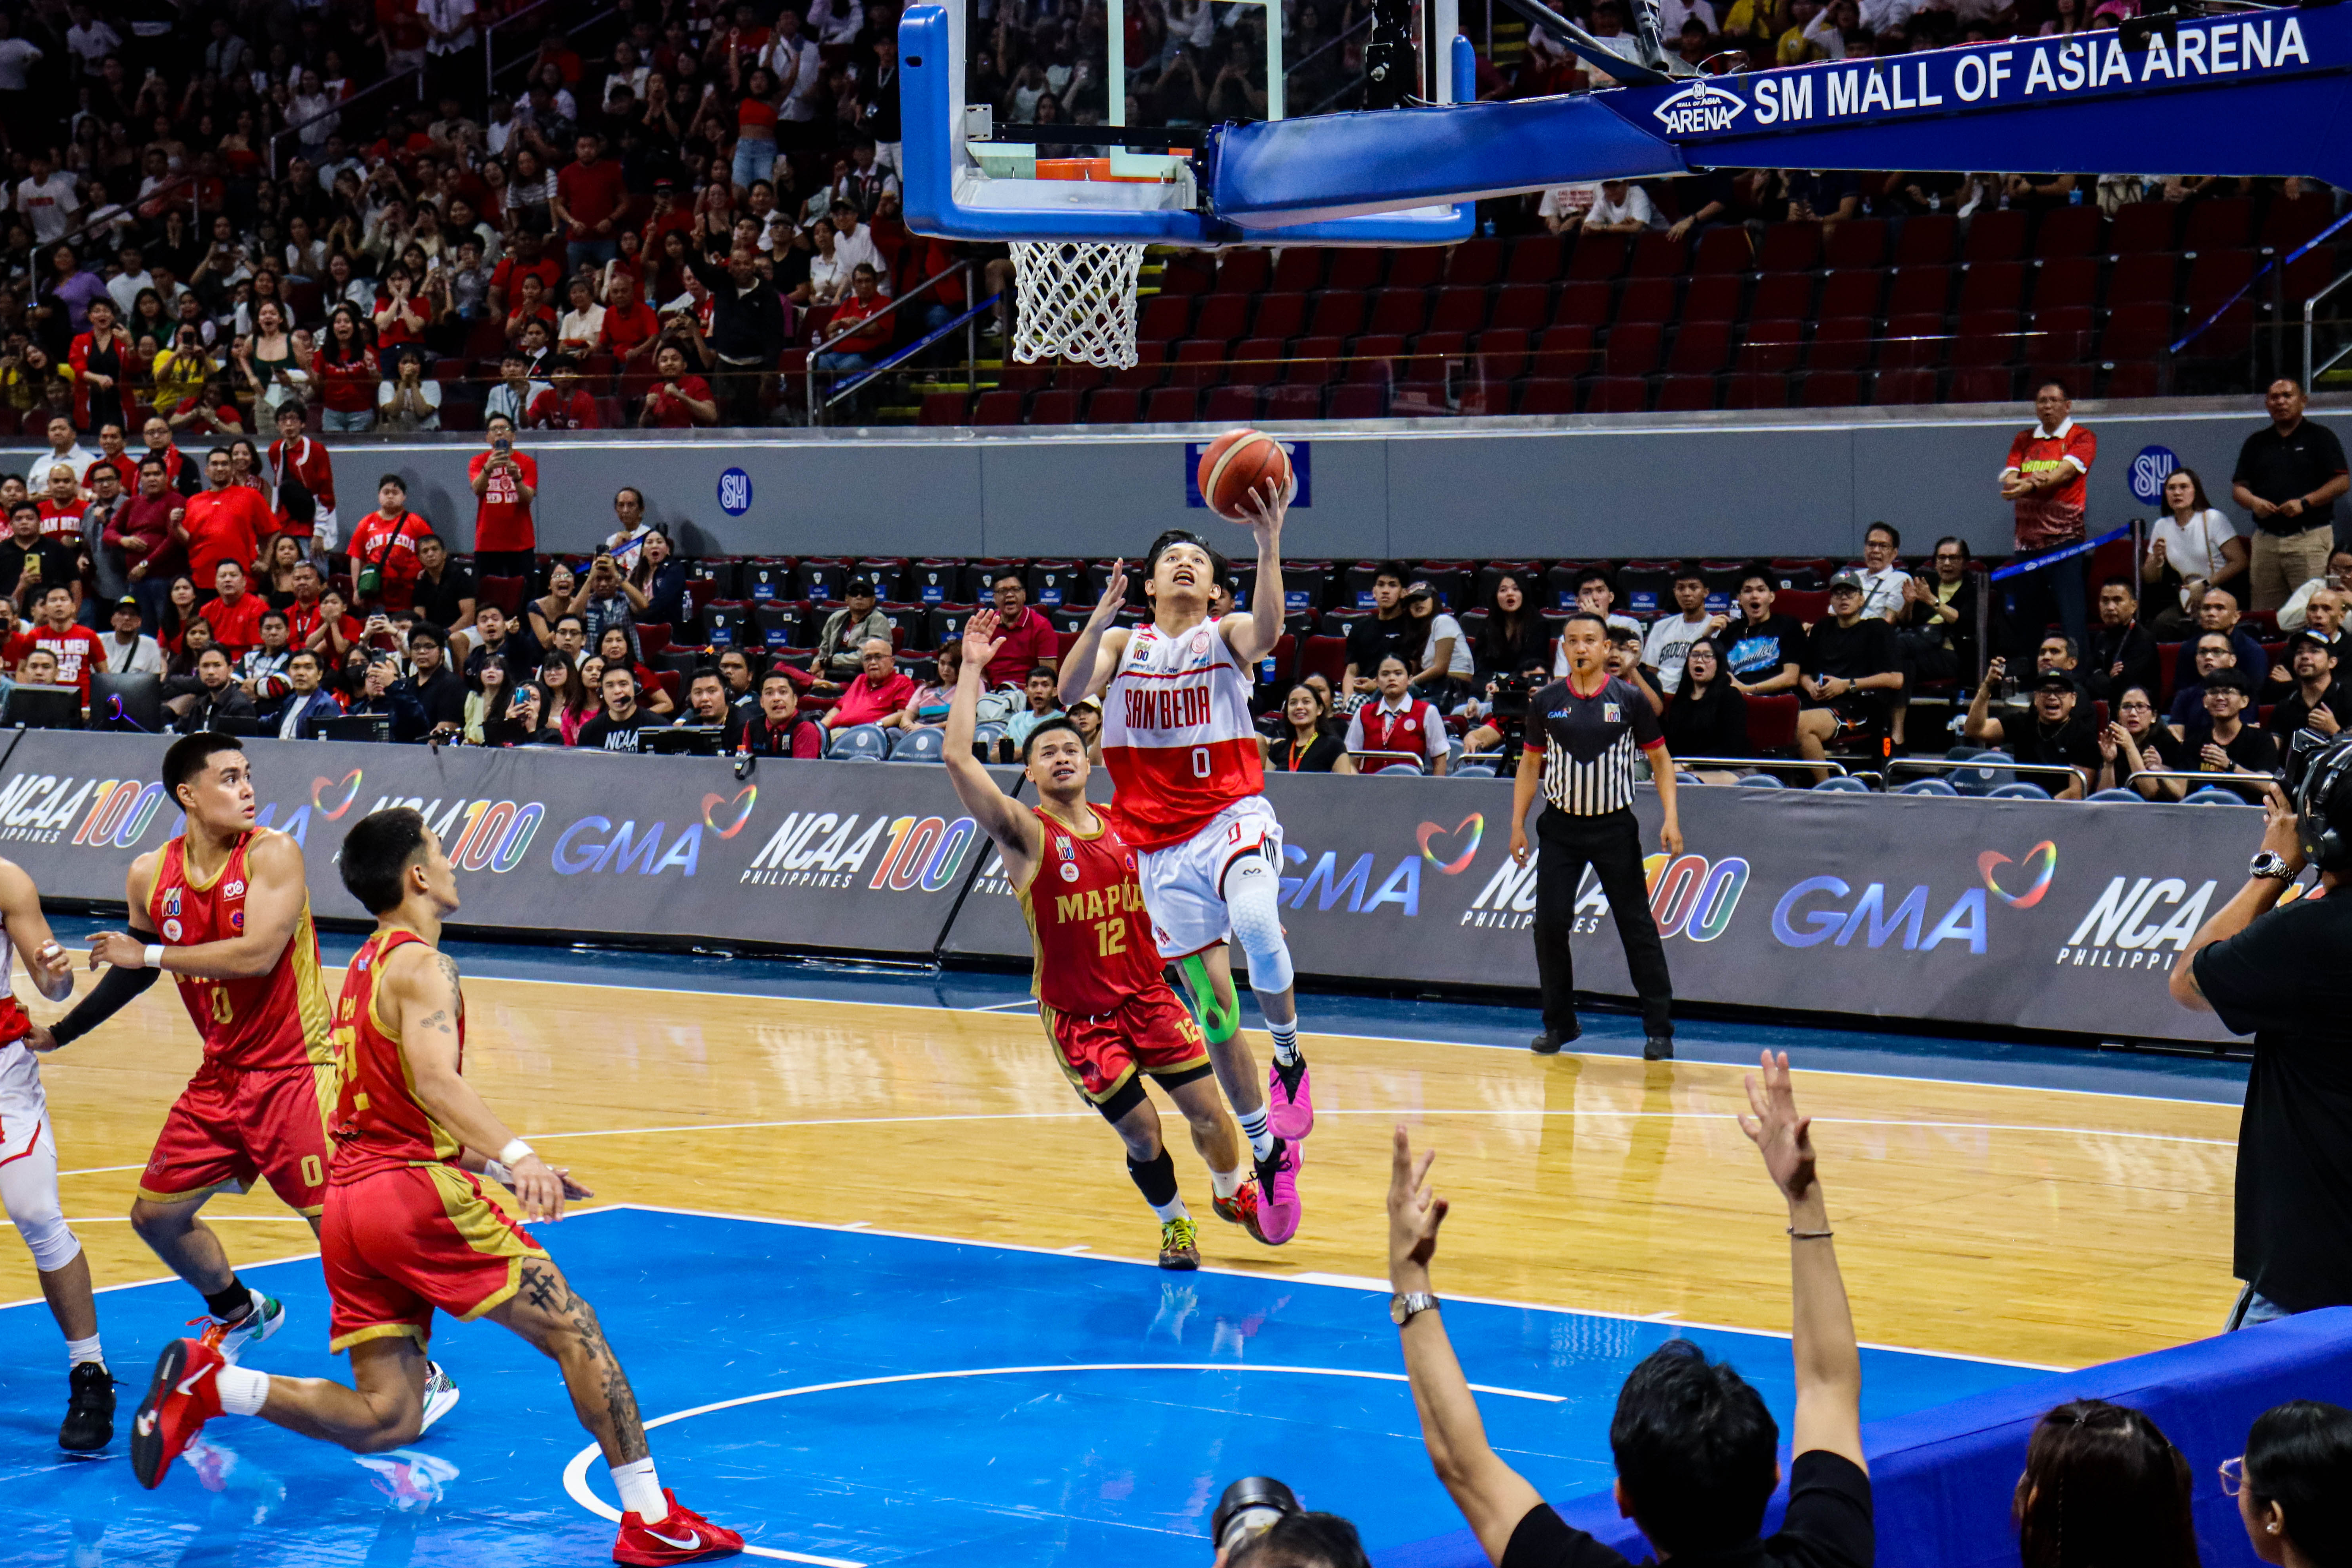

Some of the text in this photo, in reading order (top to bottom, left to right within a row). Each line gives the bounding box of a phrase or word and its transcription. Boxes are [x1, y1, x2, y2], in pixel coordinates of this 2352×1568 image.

[1754, 17, 2309, 124] SM MALL OF ASIA ARENA
[1700, 97, 1722, 106] ASIA
[1666, 106, 1732, 134] ARENA
[721, 474, 746, 509] SM
[60, 516, 81, 532] BED
[365, 532, 415, 555] SAN BEDA
[36, 639, 90, 655] REAL MEN
[1133, 649, 1149, 662] 100
[1658, 641, 1692, 665] BROOK
[56, 669, 79, 682] ED
[57, 654, 82, 670] EAR
[1125, 686, 1211, 729] SAN BEDA
[604, 730, 639, 750] NCAA
[1192, 747, 1211, 778] 0
[0, 773, 97, 830] NCAA
[71, 779, 167, 848] 100
[0, 827, 60, 844] IPPINES
[448, 799, 545, 874] 100
[551, 815, 703, 877] GMA
[750, 812, 977, 892] NCAA 100
[1059, 847, 1075, 860] 100
[740, 870, 853, 889] PHILIPPINES
[162, 899, 181, 917] 100
[1643, 852, 1750, 942] 100
[1461, 911, 1599, 933] PHILIPES
[1771, 876, 1987, 955] GMA
[2068, 876, 2218, 951] NCA
[1094, 917, 1126, 957] 12
[2056, 948, 2173, 970] PHILIPPI
[211, 987, 234, 1024] 0
[1174, 1017, 1200, 1044] 12
[301, 1154, 324, 1187] 0
